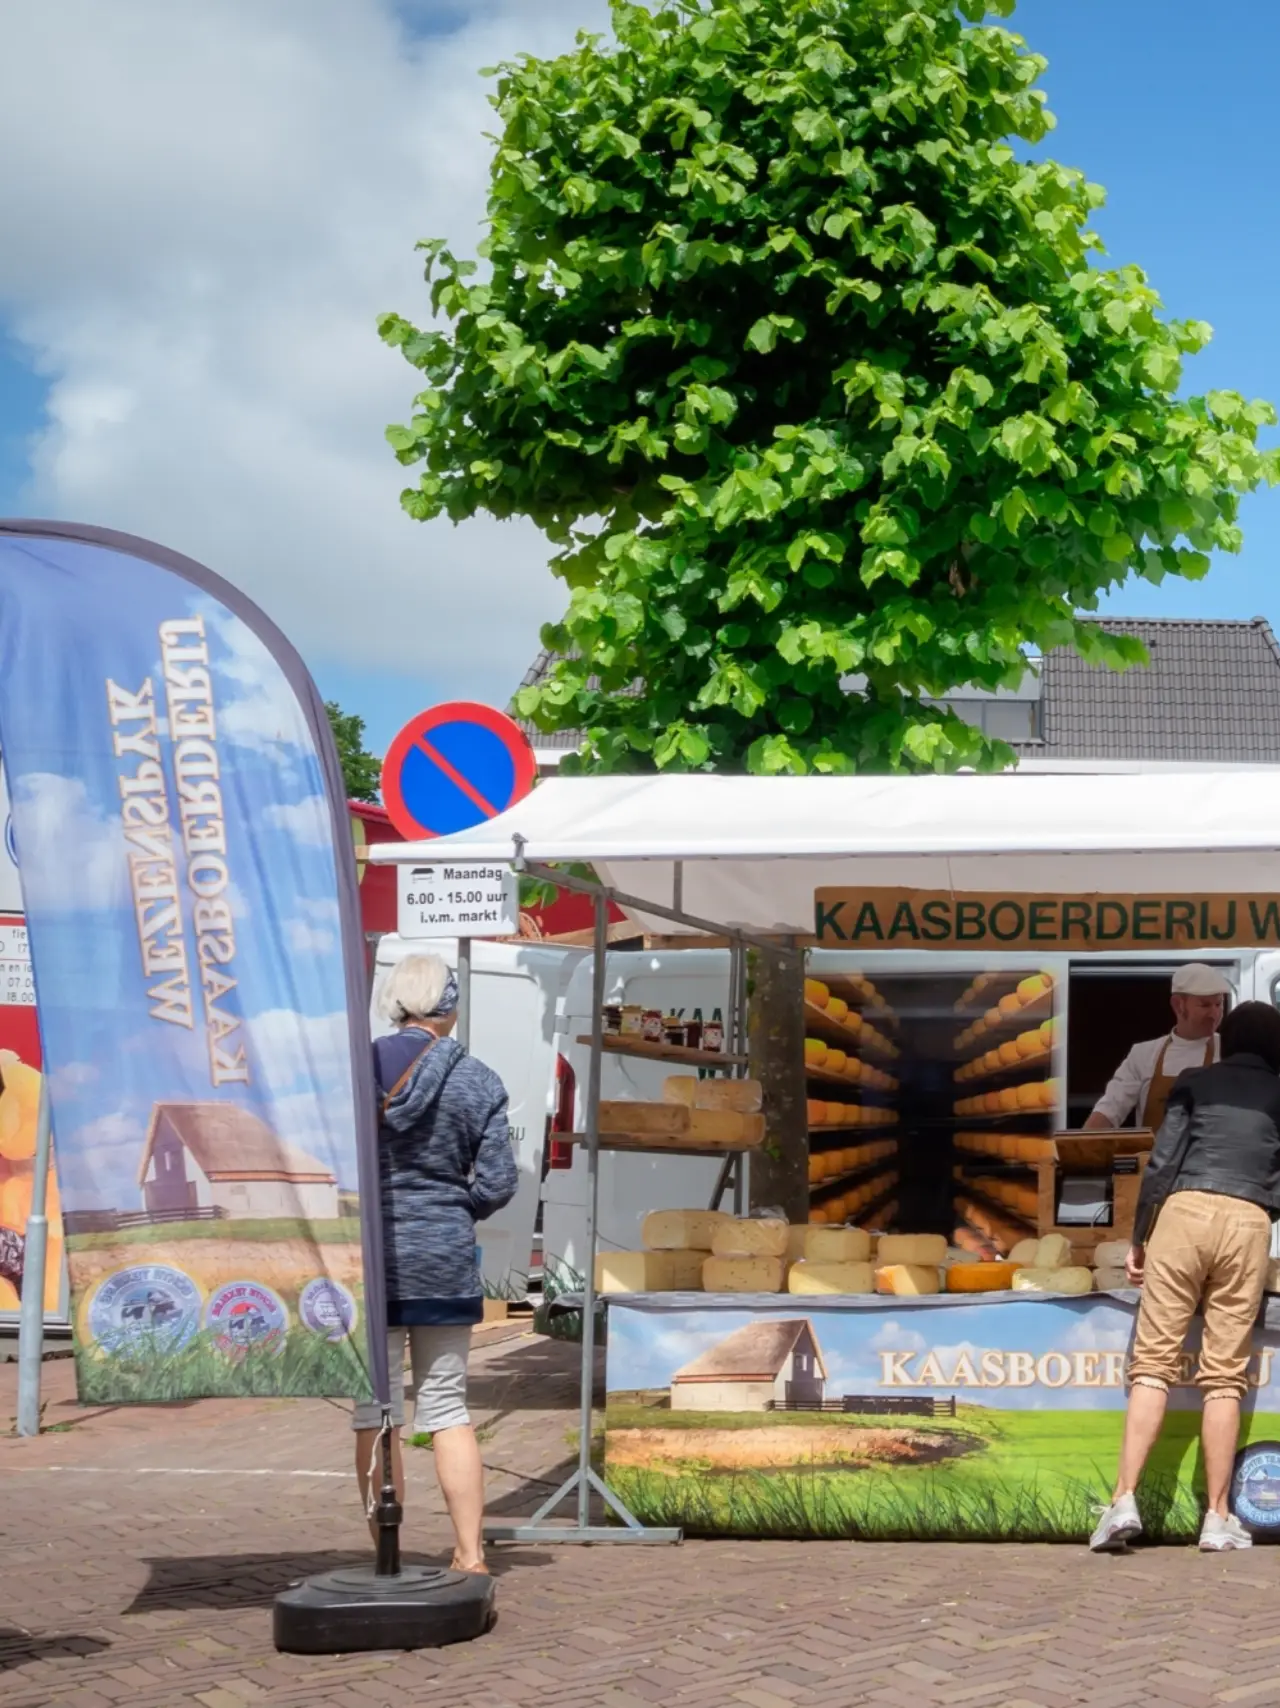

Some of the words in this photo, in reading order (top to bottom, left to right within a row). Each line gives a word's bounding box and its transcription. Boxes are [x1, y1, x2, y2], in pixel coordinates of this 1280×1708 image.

[443, 867, 502, 881] Maandag
[407, 892, 435, 905] 6.00
[447, 890, 482, 903] 15.00
[487, 892, 508, 902] uur
[420, 911, 454, 923] i.v.m.
[458, 909, 497, 922] markt
[815, 900, 1237, 941] KAASBOERDERIJ
